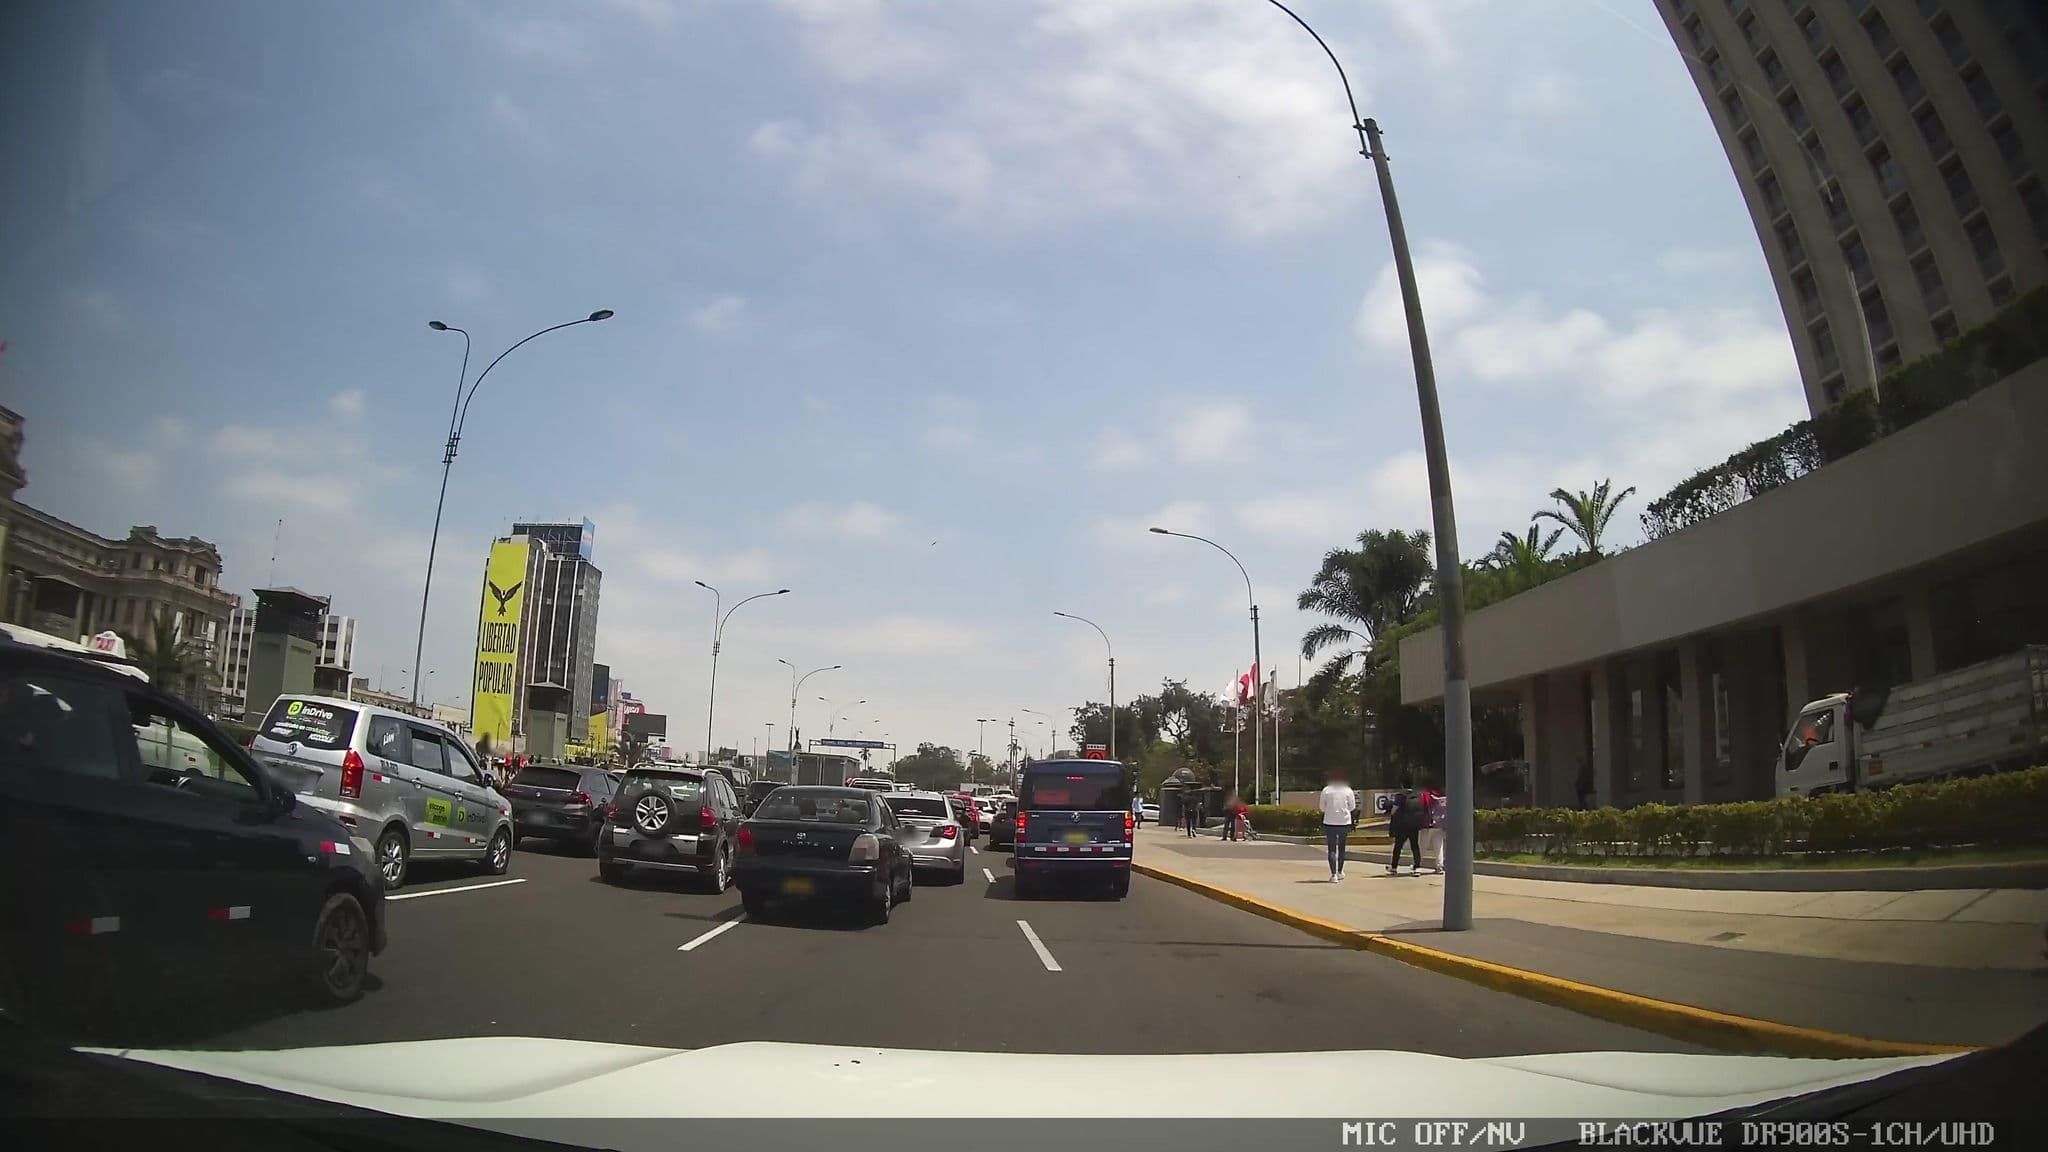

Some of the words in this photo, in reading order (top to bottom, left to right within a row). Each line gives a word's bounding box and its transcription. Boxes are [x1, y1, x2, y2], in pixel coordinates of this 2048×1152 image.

[481, 621, 517, 653] LIBERTAD
[478, 661, 512, 694] POPULAR
[301, 705, 334, 720] inDrive
